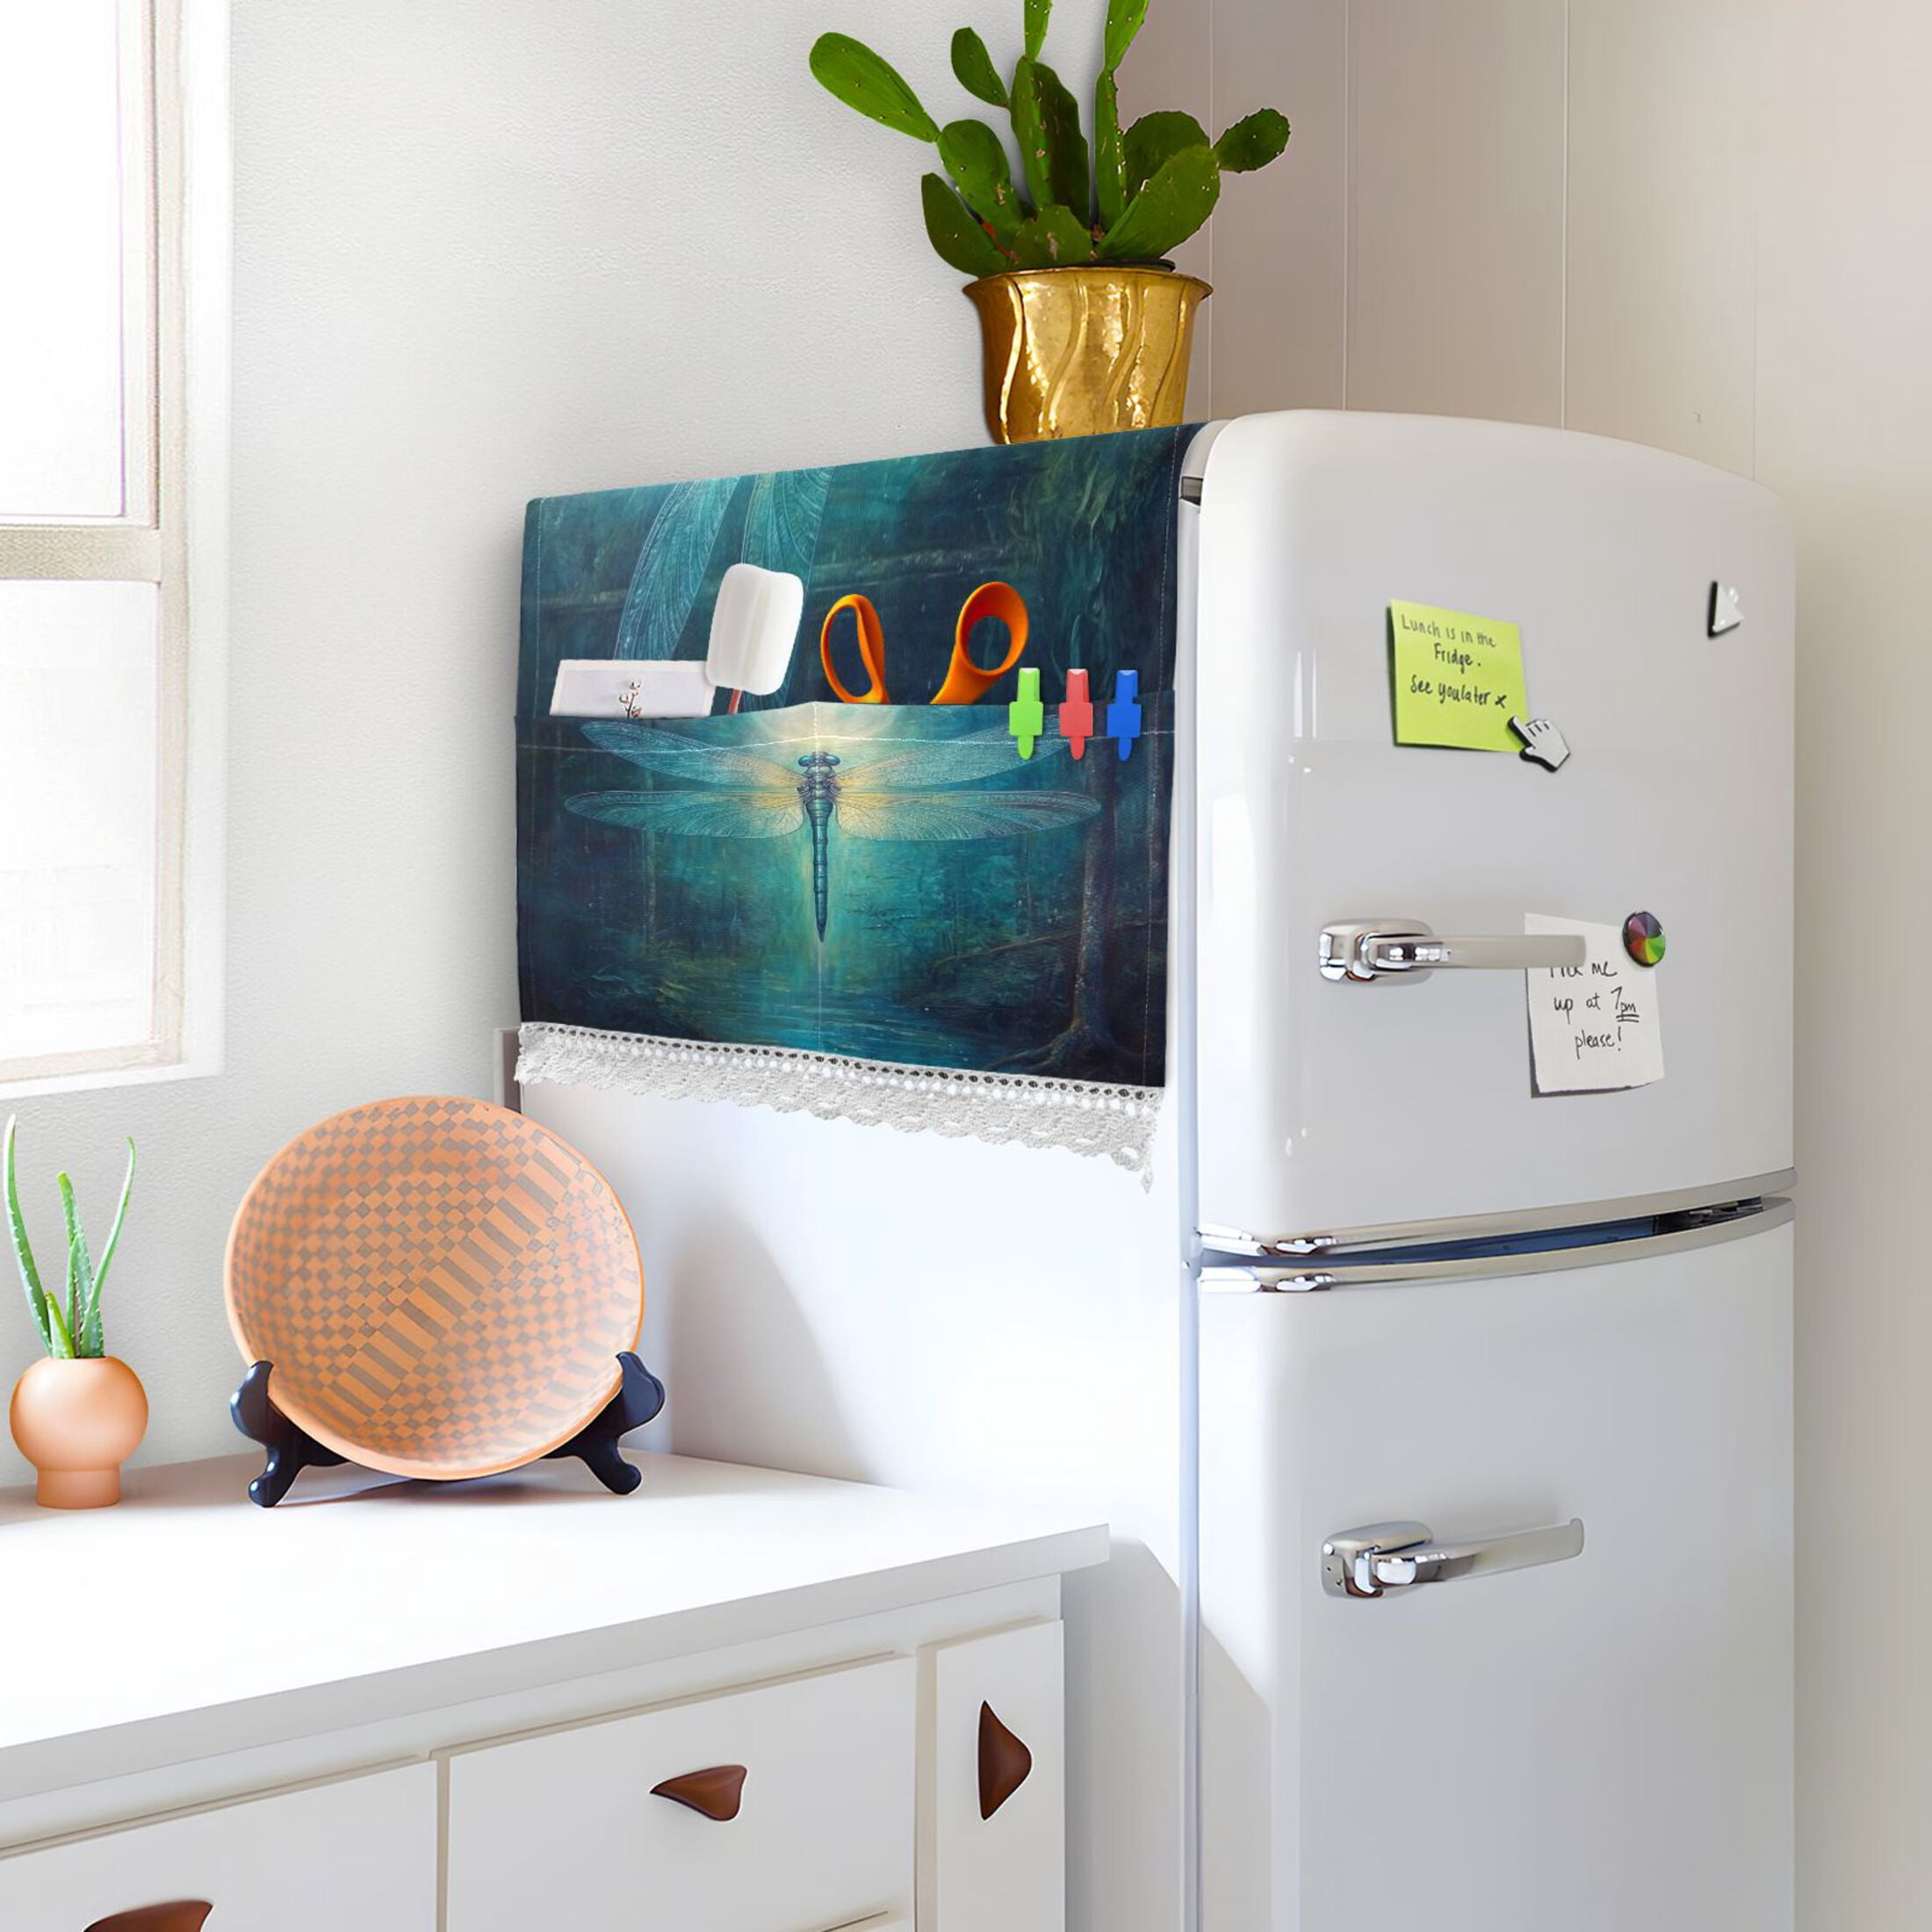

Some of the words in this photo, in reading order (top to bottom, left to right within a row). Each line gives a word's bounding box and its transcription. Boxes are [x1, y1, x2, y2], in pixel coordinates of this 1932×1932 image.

[1402, 614, 1440, 638] Lunch
[1477, 632, 1496, 647] the
[1410, 674, 1432, 695] See
[1554, 997, 1573, 1024] up
[1586, 991, 1601, 1010] at
[1575, 1027, 1622, 1060] please!
